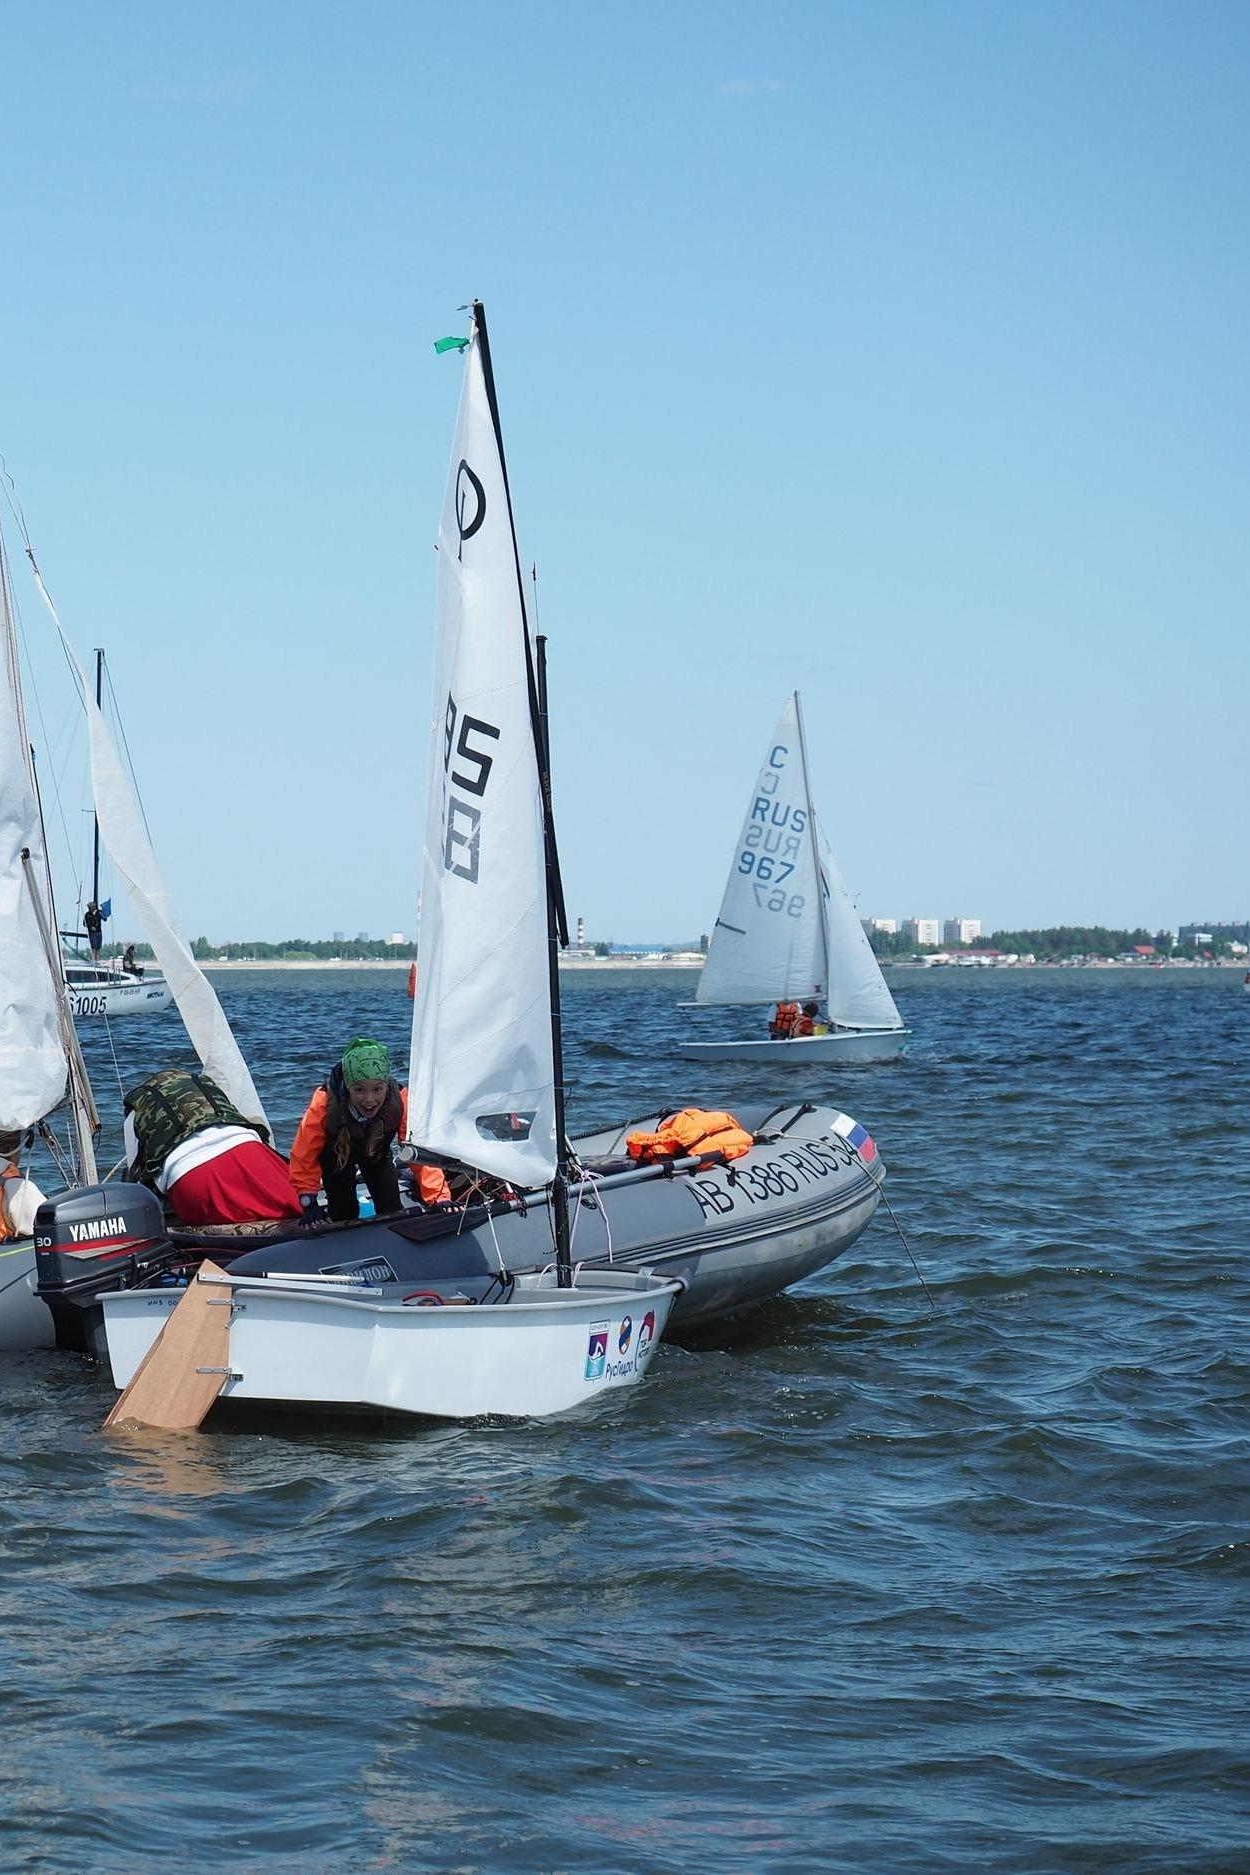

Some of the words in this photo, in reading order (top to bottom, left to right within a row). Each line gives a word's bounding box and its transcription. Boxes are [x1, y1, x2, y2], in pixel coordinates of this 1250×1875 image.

[769, 745, 788, 769] C
[751, 797, 807, 833] RUS
[738, 851, 795, 884] 967
[726, 1162, 799, 1204] 1386
[779, 1143, 839, 1184] RUS
[820, 1132, 862, 1165] 54
[36, 1237, 52, 1247] 30
[69, 1216, 127, 1242] YAMAHA
[605, 1361, 633, 1381] РусГидро
